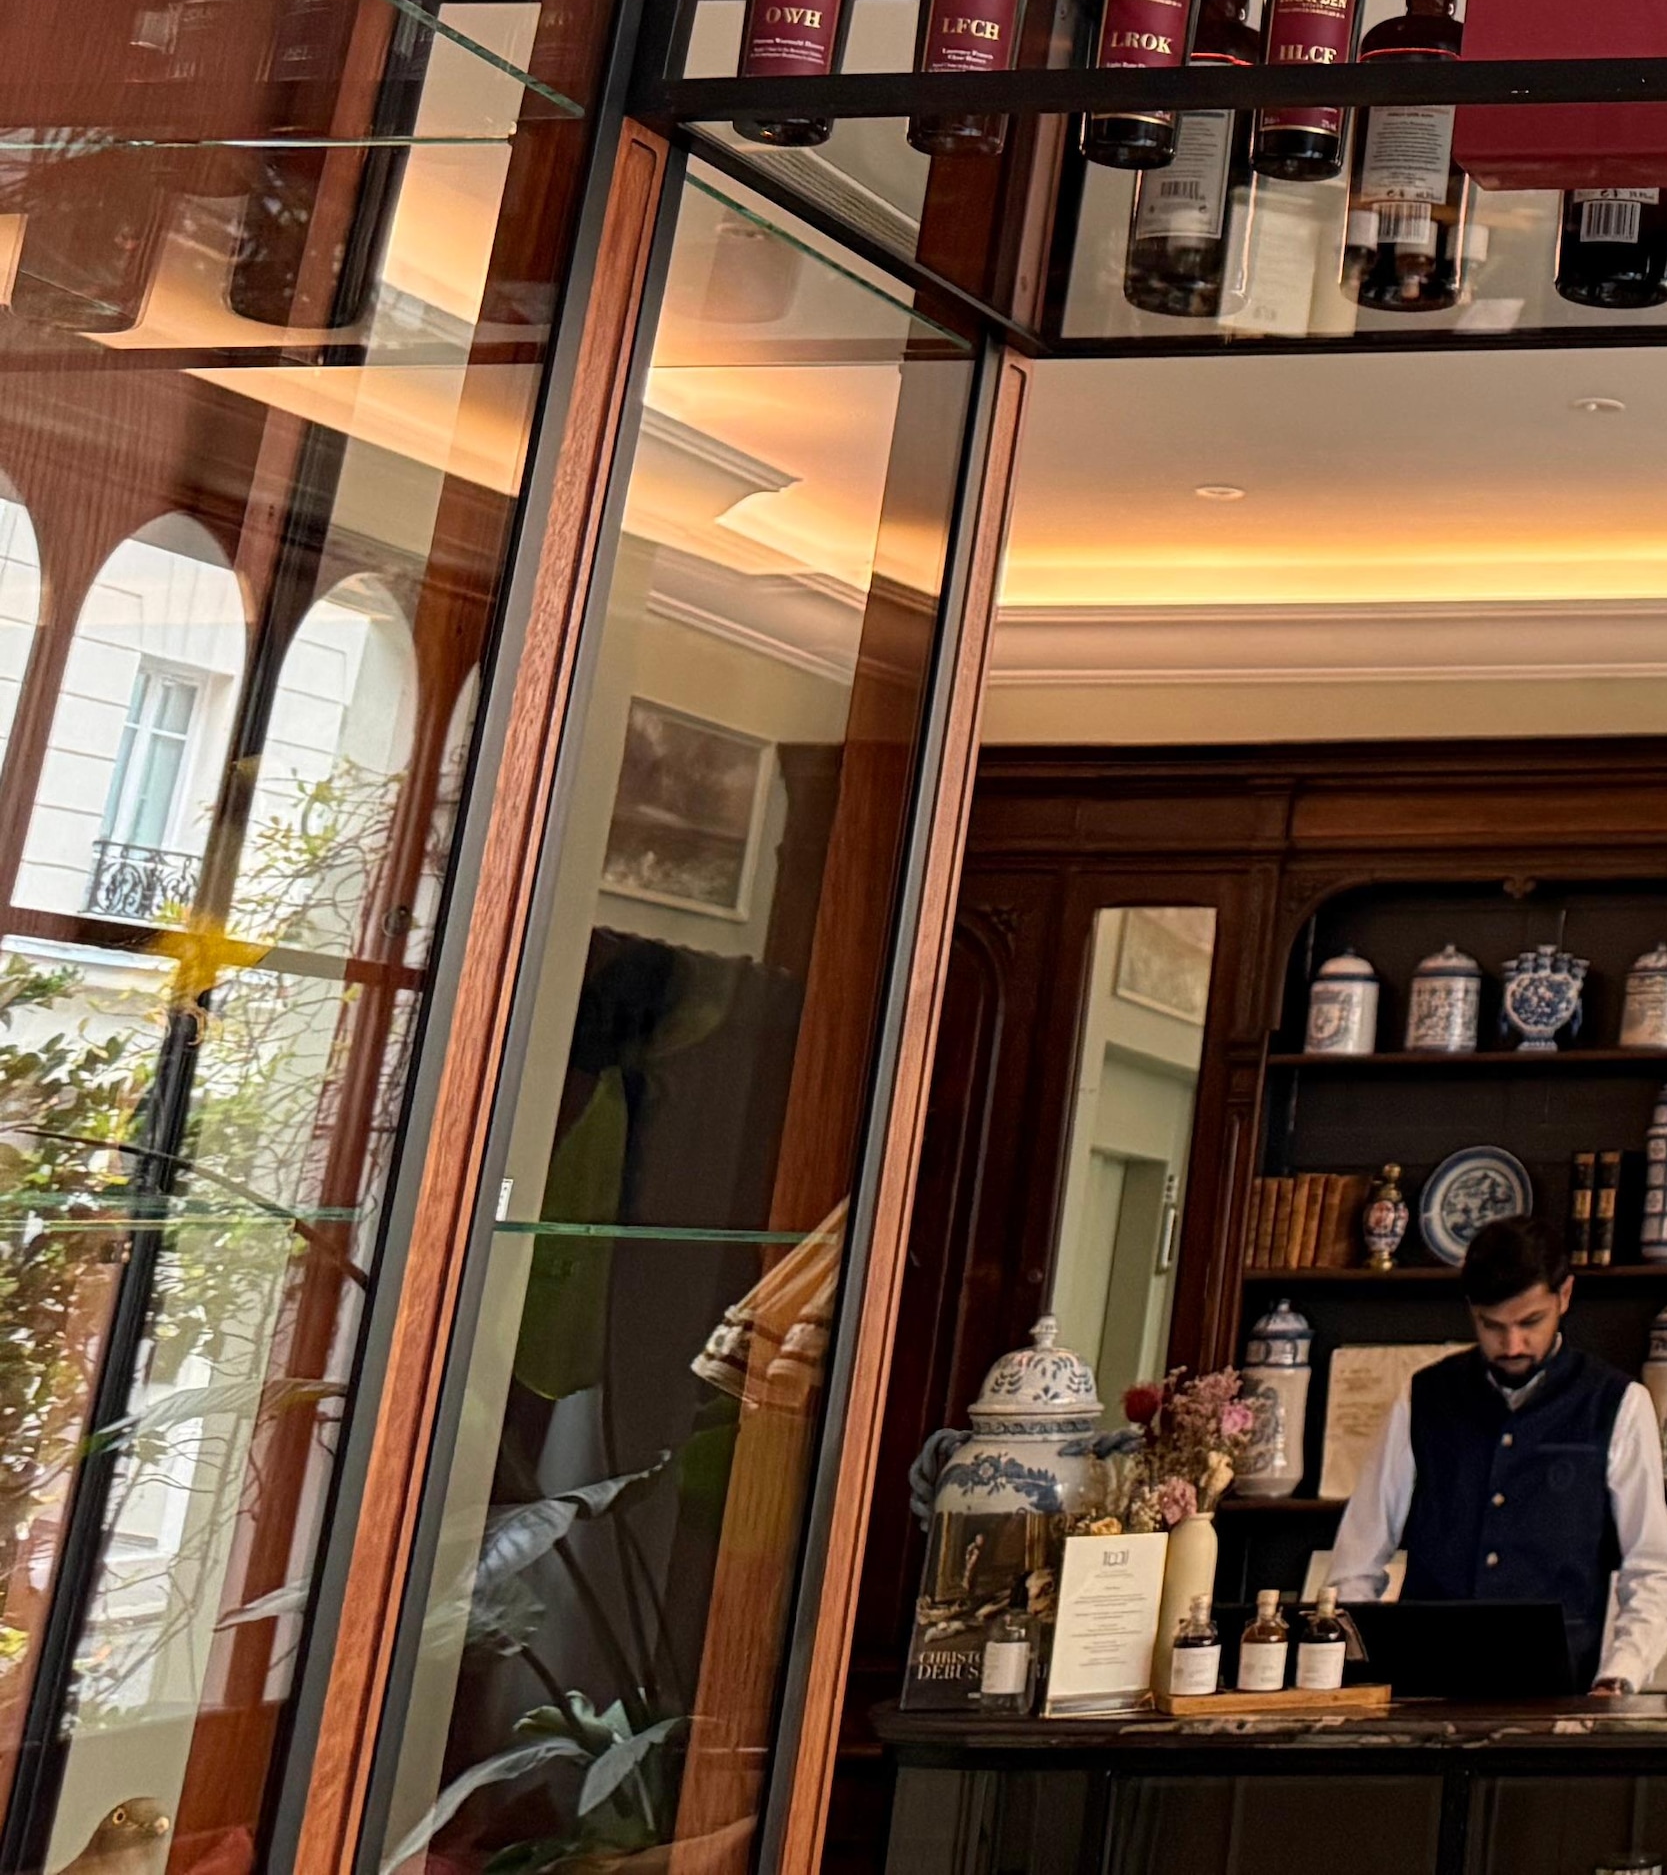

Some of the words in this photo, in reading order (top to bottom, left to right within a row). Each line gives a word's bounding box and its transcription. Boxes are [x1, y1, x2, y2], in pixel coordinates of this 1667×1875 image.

[766, 6, 822, 29] OWH
[942, 17, 1000, 41] LFCH
[1111, 31, 1174, 55] LROK
[1279, 43, 1337, 64] HLCF
